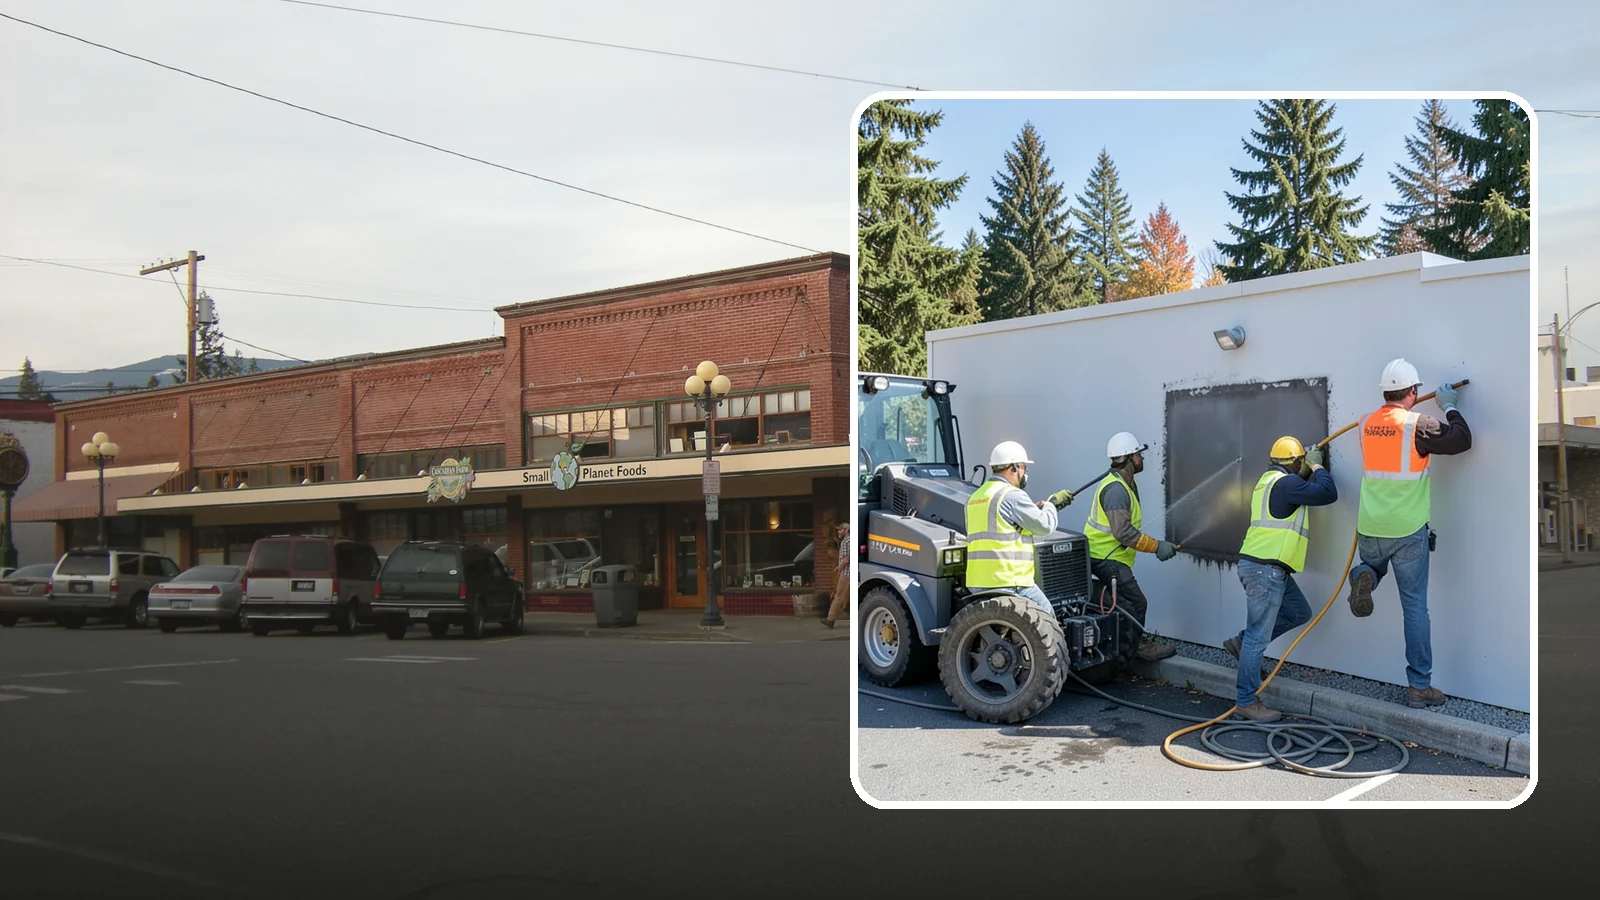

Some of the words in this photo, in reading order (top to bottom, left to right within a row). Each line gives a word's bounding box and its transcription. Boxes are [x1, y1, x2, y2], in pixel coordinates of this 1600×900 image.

[523, 470, 549, 483] Small
[582, 467, 614, 479] Planet
[616, 464, 647, 477] Foods
